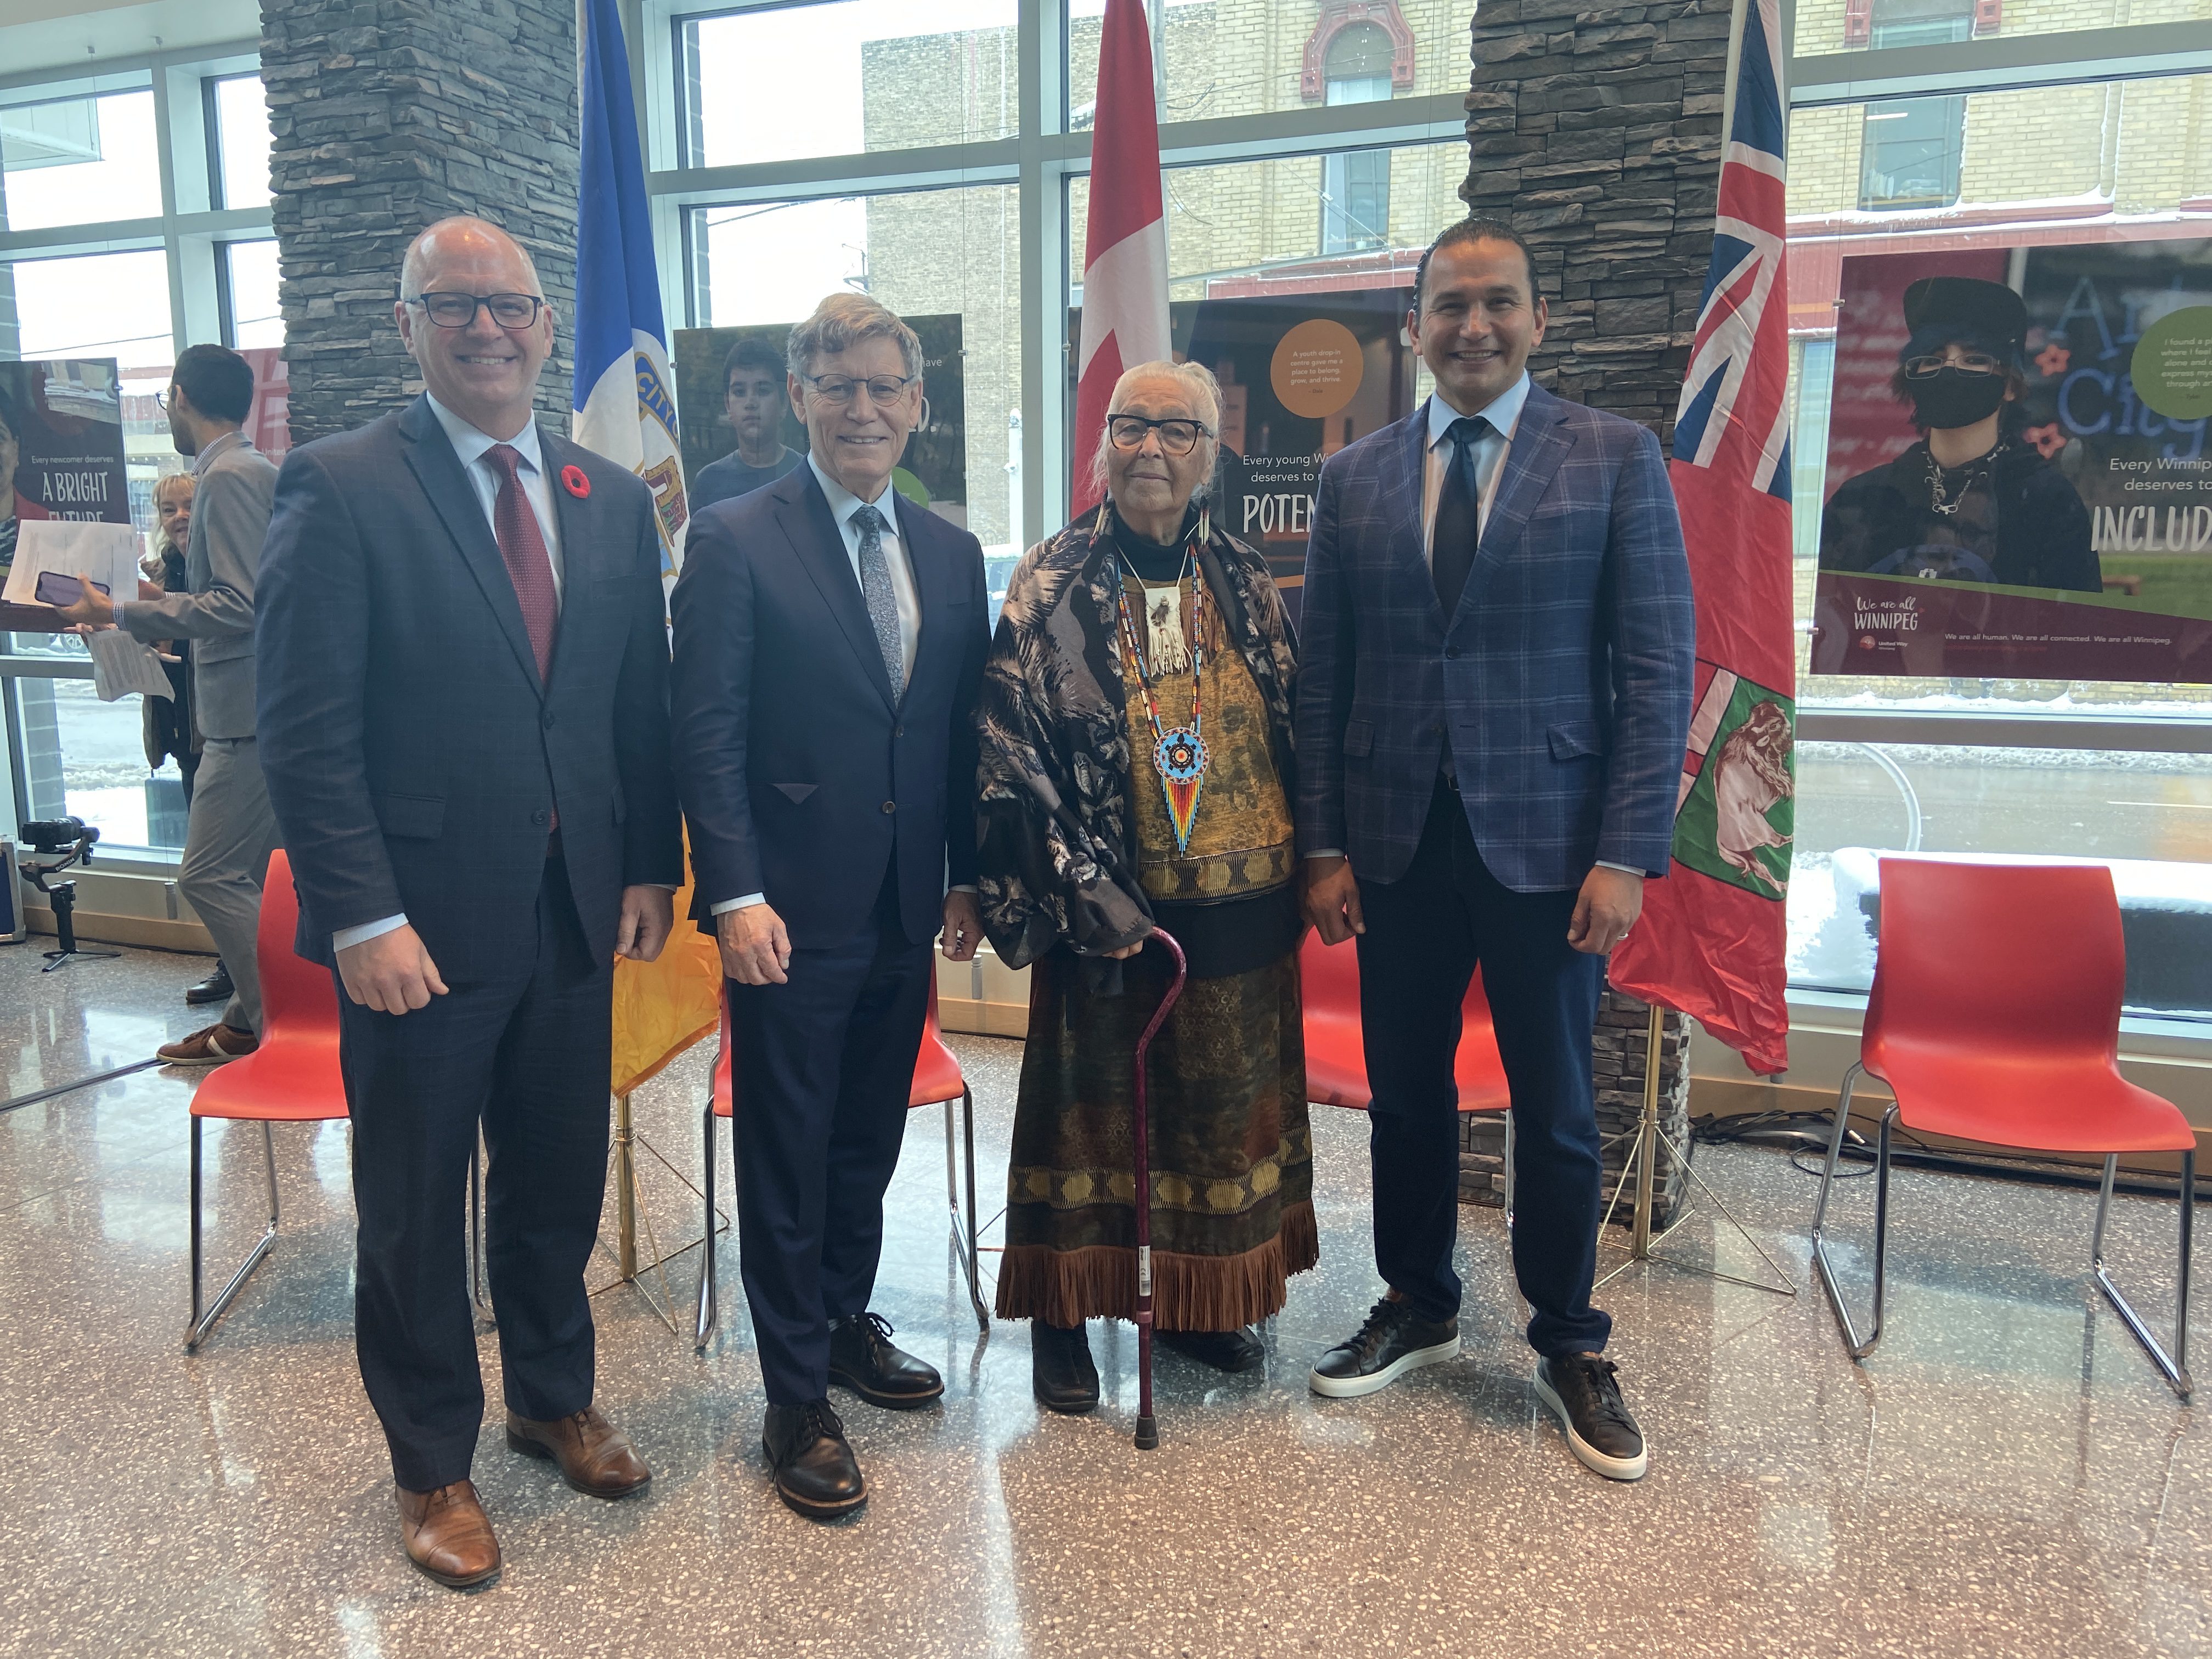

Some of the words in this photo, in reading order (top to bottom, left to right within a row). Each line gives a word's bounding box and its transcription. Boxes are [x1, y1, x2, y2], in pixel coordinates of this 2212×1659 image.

[1299, 350, 1317, 358] youth
[1291, 369, 1308, 377] place
[2167, 380, 2200, 388] through
[636, 372, 673, 423] CITY
[32, 456, 48, 465] Every
[84, 455, 114, 463] deserves
[1243, 455, 1273, 467] Every
[1276, 456, 1310, 467] young
[2110, 458, 2152, 473] Every
[2157, 458, 2212, 472] Winnip
[1251, 471, 1299, 482] deserves
[1302, 472, 1314, 481] to
[43, 472, 53, 501] A
[55, 471, 108, 502] BRIGHT
[2124, 478, 2193, 490] deserves
[2198, 479, 2212, 490] to
[2091, 505, 2212, 551] INCLUD
[1857, 596, 1877, 611] We
[1899, 596, 1916, 611] all
[1854, 612, 1918, 631] WINNIPEG
[2134, 636, 2172, 645] Winnipeg.
